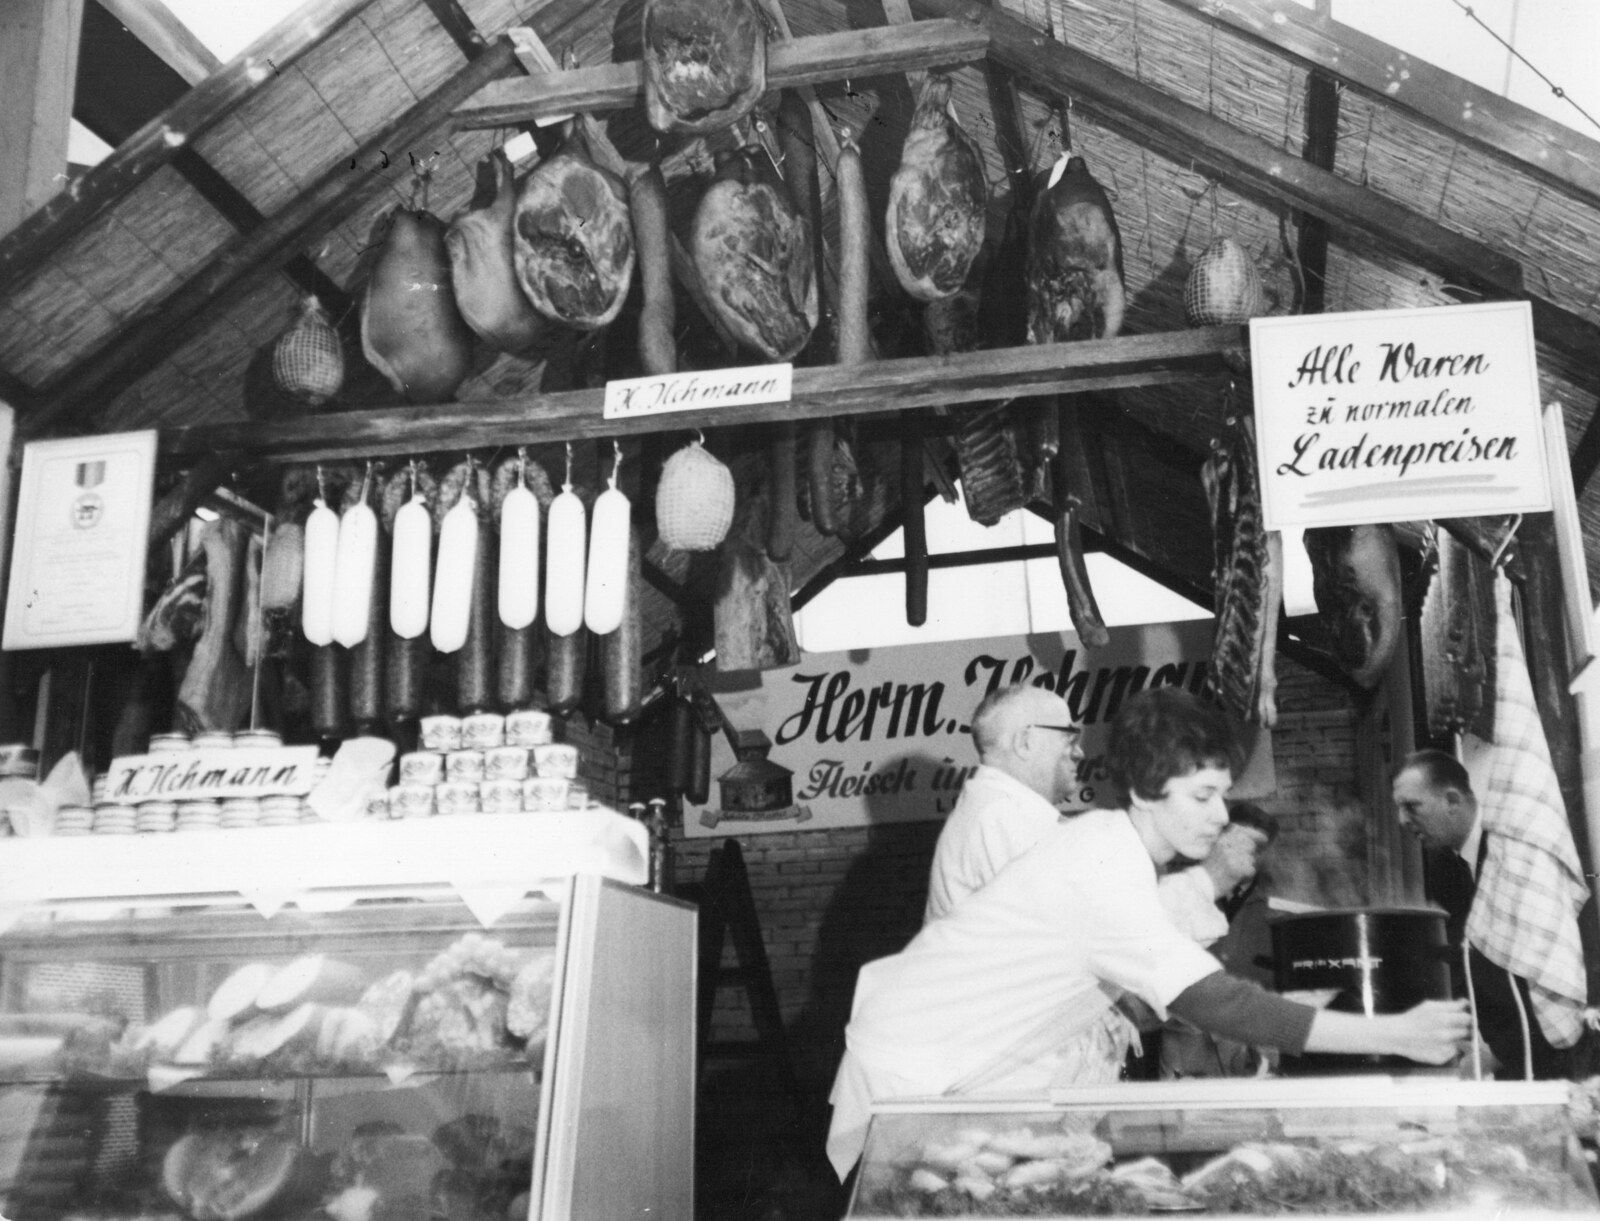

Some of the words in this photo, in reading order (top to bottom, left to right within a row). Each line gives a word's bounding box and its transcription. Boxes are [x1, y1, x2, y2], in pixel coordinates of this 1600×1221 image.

[1288, 343, 1361, 389] Alle
[1379, 341, 1490, 384] Waren
[1345, 388, 1477, 424] normalen
[1276, 427, 1519, 478] Ladenpreisen
[775, 670, 957, 746] Herm.
[797, 757, 917, 801] Fleisch
